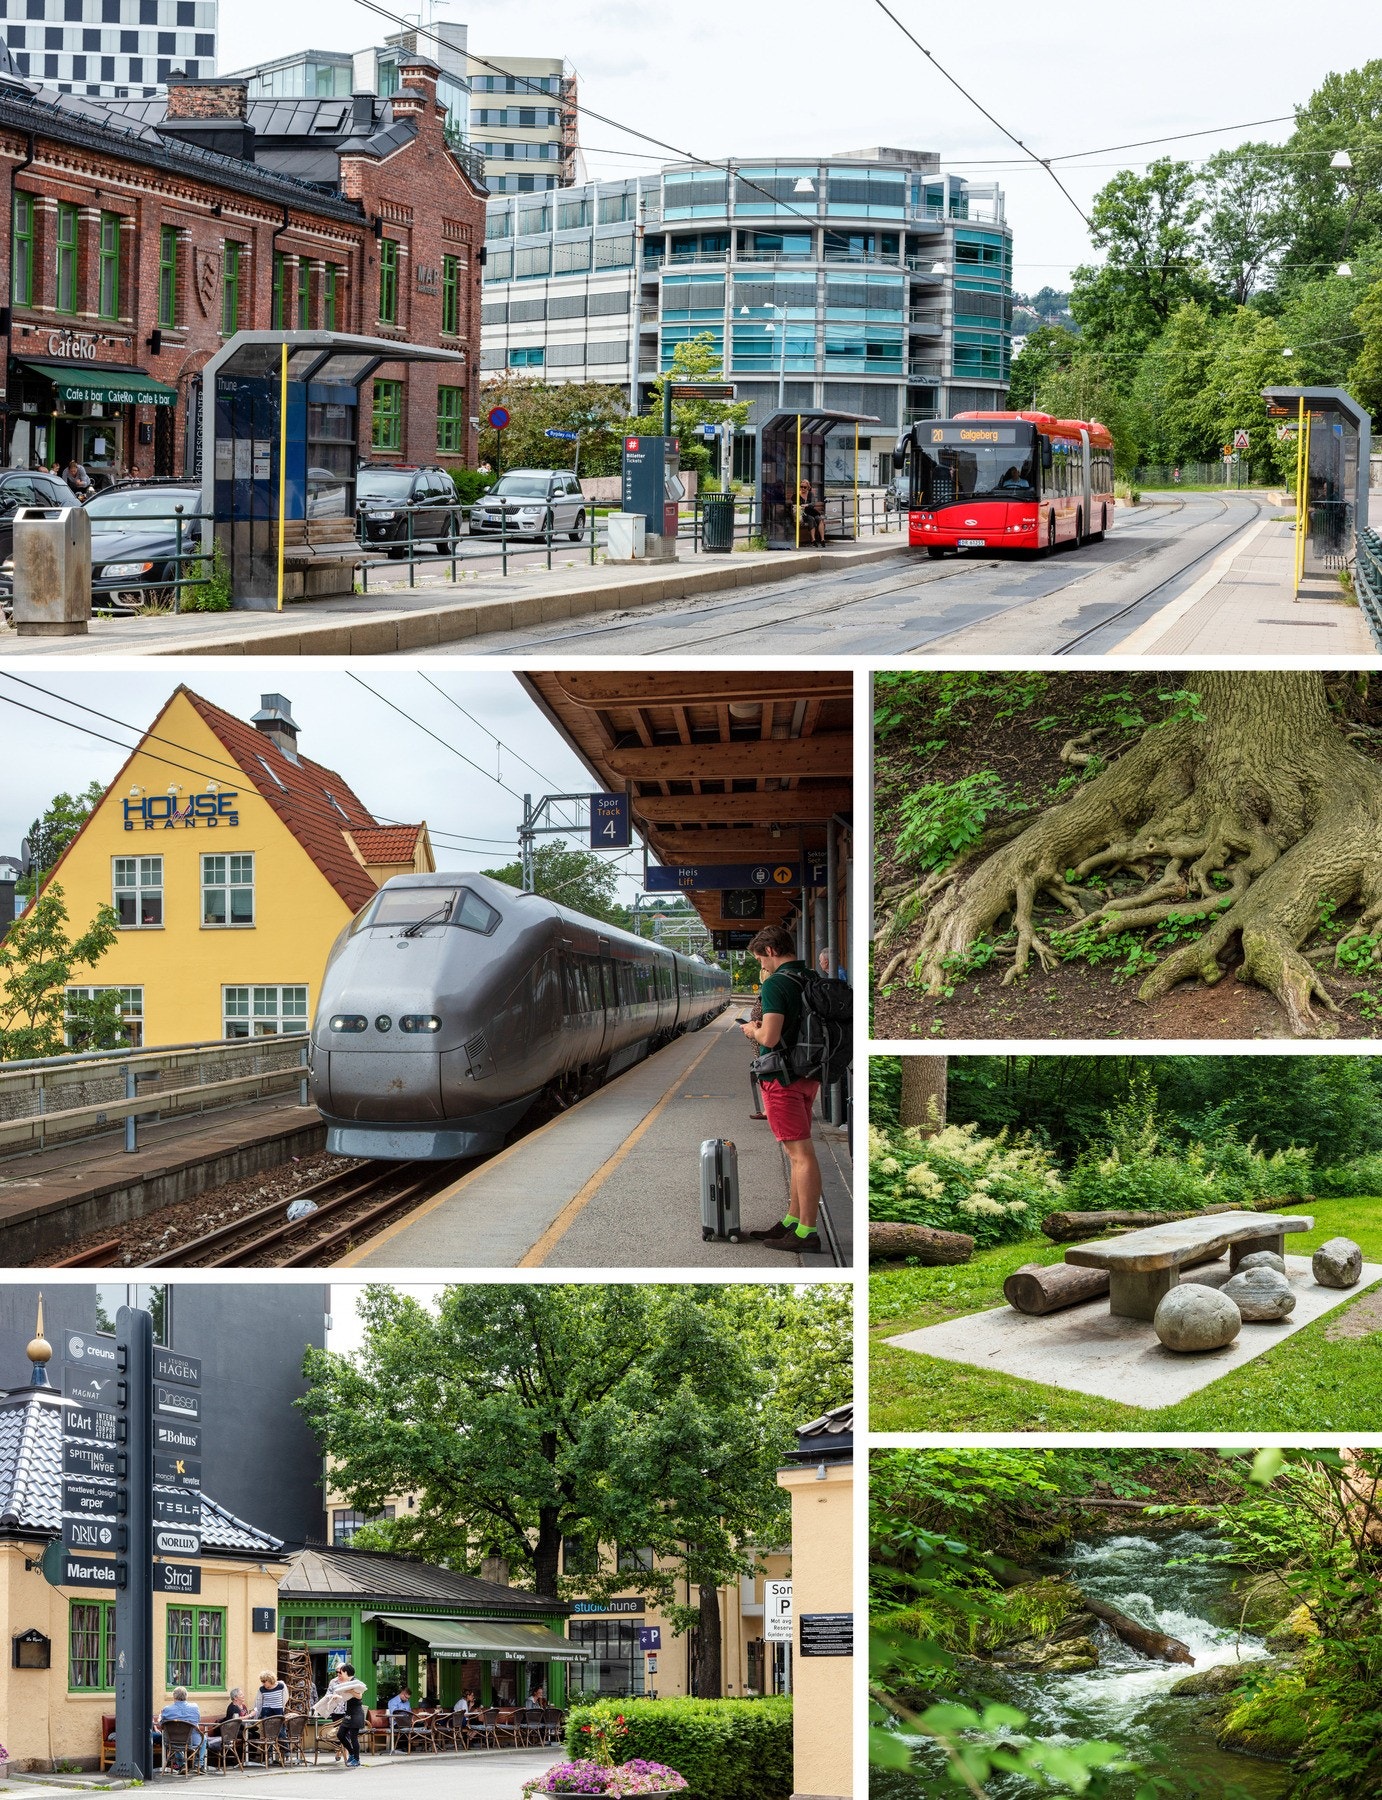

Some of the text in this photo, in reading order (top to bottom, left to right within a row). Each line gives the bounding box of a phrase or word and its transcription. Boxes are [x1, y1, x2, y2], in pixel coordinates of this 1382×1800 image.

[48, 334, 96, 360] CafeRo
[217, 377, 238, 391] Thune
[66, 387, 170, 405] Cafe & bar CafeRo Cafe & bar
[933, 429, 998, 442] 20 Galgeberg
[123, 792, 239, 820] HOUSE
[598, 798, 619, 808] Spor
[597, 808, 621, 816] Track
[124, 815, 239, 831] BRANDS
[602, 820, 616, 839] 4
[678, 868, 698, 877] Heis
[813, 865, 823, 881] F
[678, 877, 694, 886] Lift
[87, 1346, 115, 1360] creuna
[168, 1358, 189, 1367] STUDIO
[159, 1361, 198, 1380] HAGEN
[71, 1388, 100, 1400] MAGNAT
[158, 1388, 198, 1410] Dinesen
[67, 1411, 92, 1431] ICArt
[96, 1412, 116, 1421] INTERN
[167, 1429, 197, 1447] Bohus
[69, 1449, 104, 1462] SPITTING
[67, 1485, 117, 1499] nextlevel_design
[80, 1497, 104, 1509] arper
[157, 1501, 200, 1515] TESLA
[161, 1536, 195, 1549] NORLUX
[67, 1563, 116, 1581] Martela
[164, 1565, 193, 1587] Strai
[781, 1599, 791, 1614] P
[264, 1621, 269, 1630] 1
[651, 1629, 659, 1643] P
[433, 1650, 461, 1658] restaurant
[462, 1650, 468, 1658] &
[505, 1651, 513, 1659] Da
[513, 1652, 526, 1661] Capo
[551, 1654, 574, 1662] restaurant
[574, 1654, 579, 1662] &
